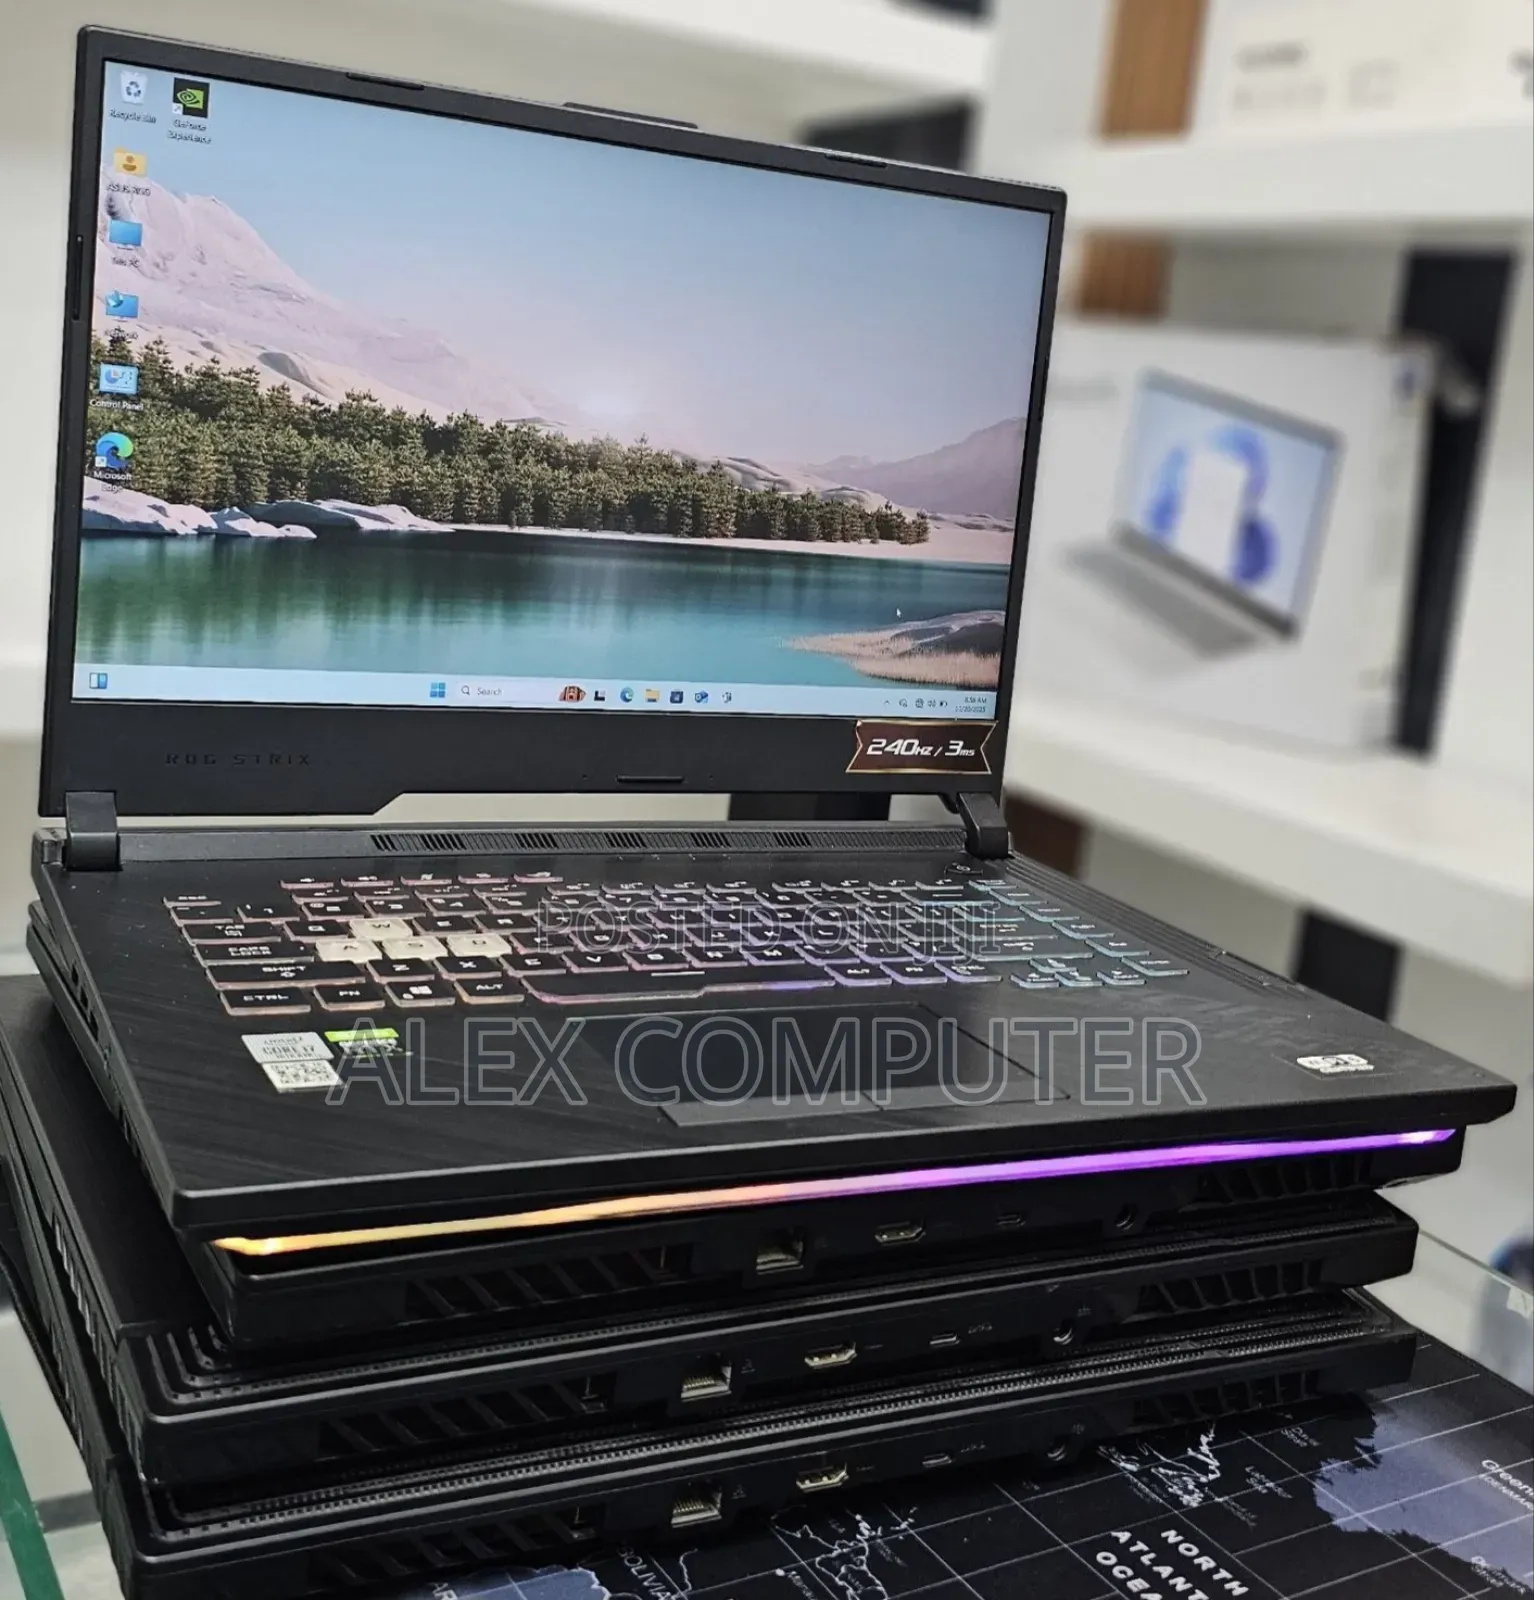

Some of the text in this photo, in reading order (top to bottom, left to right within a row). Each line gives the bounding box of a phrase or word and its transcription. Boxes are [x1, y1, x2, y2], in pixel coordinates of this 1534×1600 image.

[122, 401, 144, 411] Panel
[93, 470, 132, 480] Microsoft
[477, 687, 502, 696] Search
[233, 753, 310, 766] STRIX
[1160, 1529, 1250, 1597] NORTH
